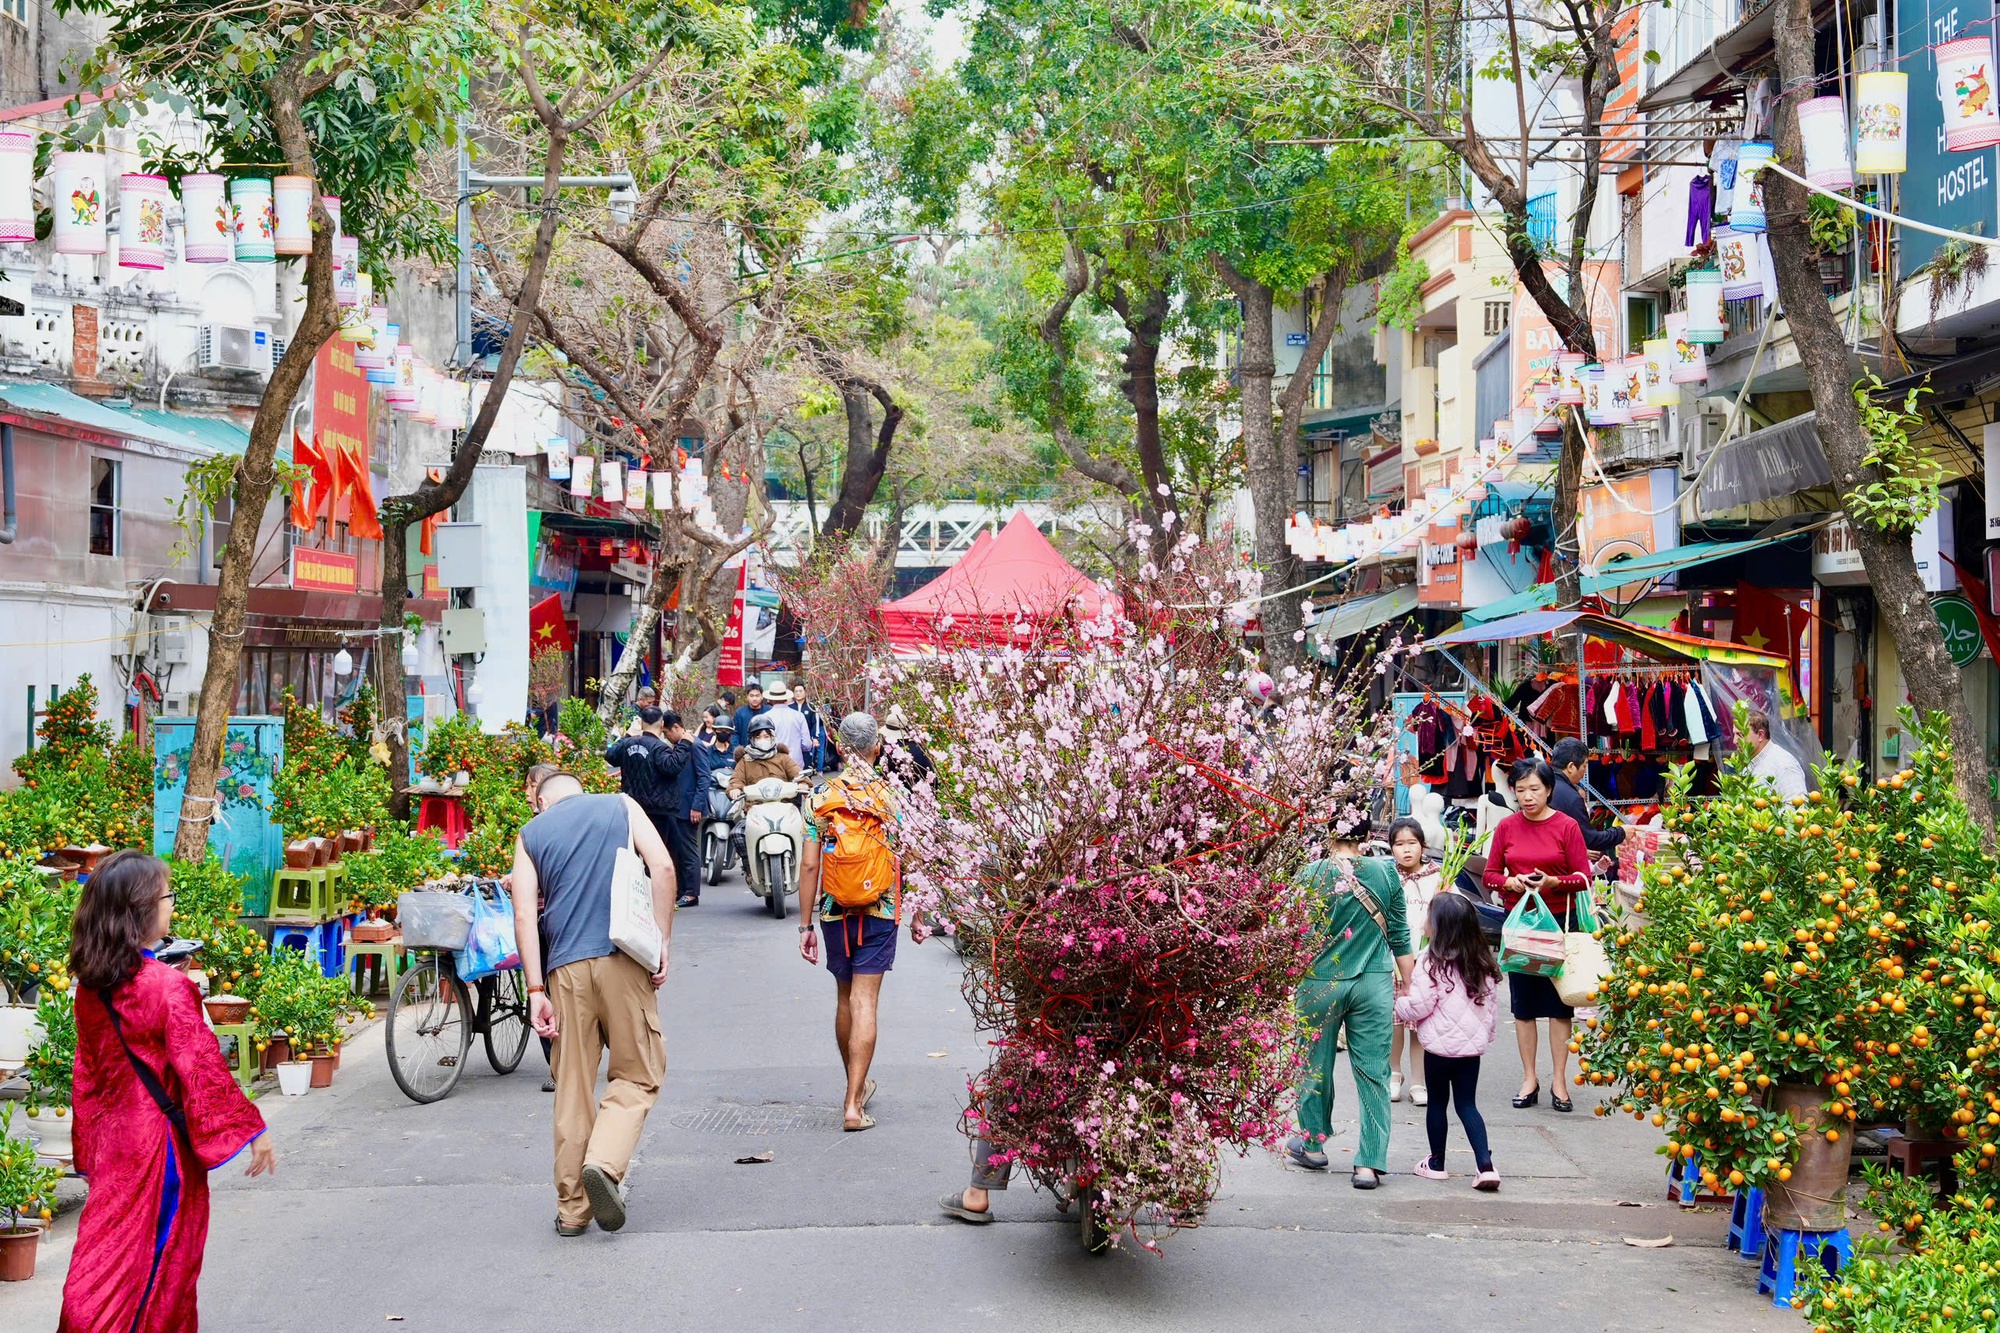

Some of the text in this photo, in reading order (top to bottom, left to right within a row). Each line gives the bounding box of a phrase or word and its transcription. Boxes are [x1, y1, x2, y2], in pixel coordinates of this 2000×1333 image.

[1934, 7, 1959, 45] THE
[1937, 155, 1988, 207] HOSTEL
[1949, 643, 1973, 652] LAL
